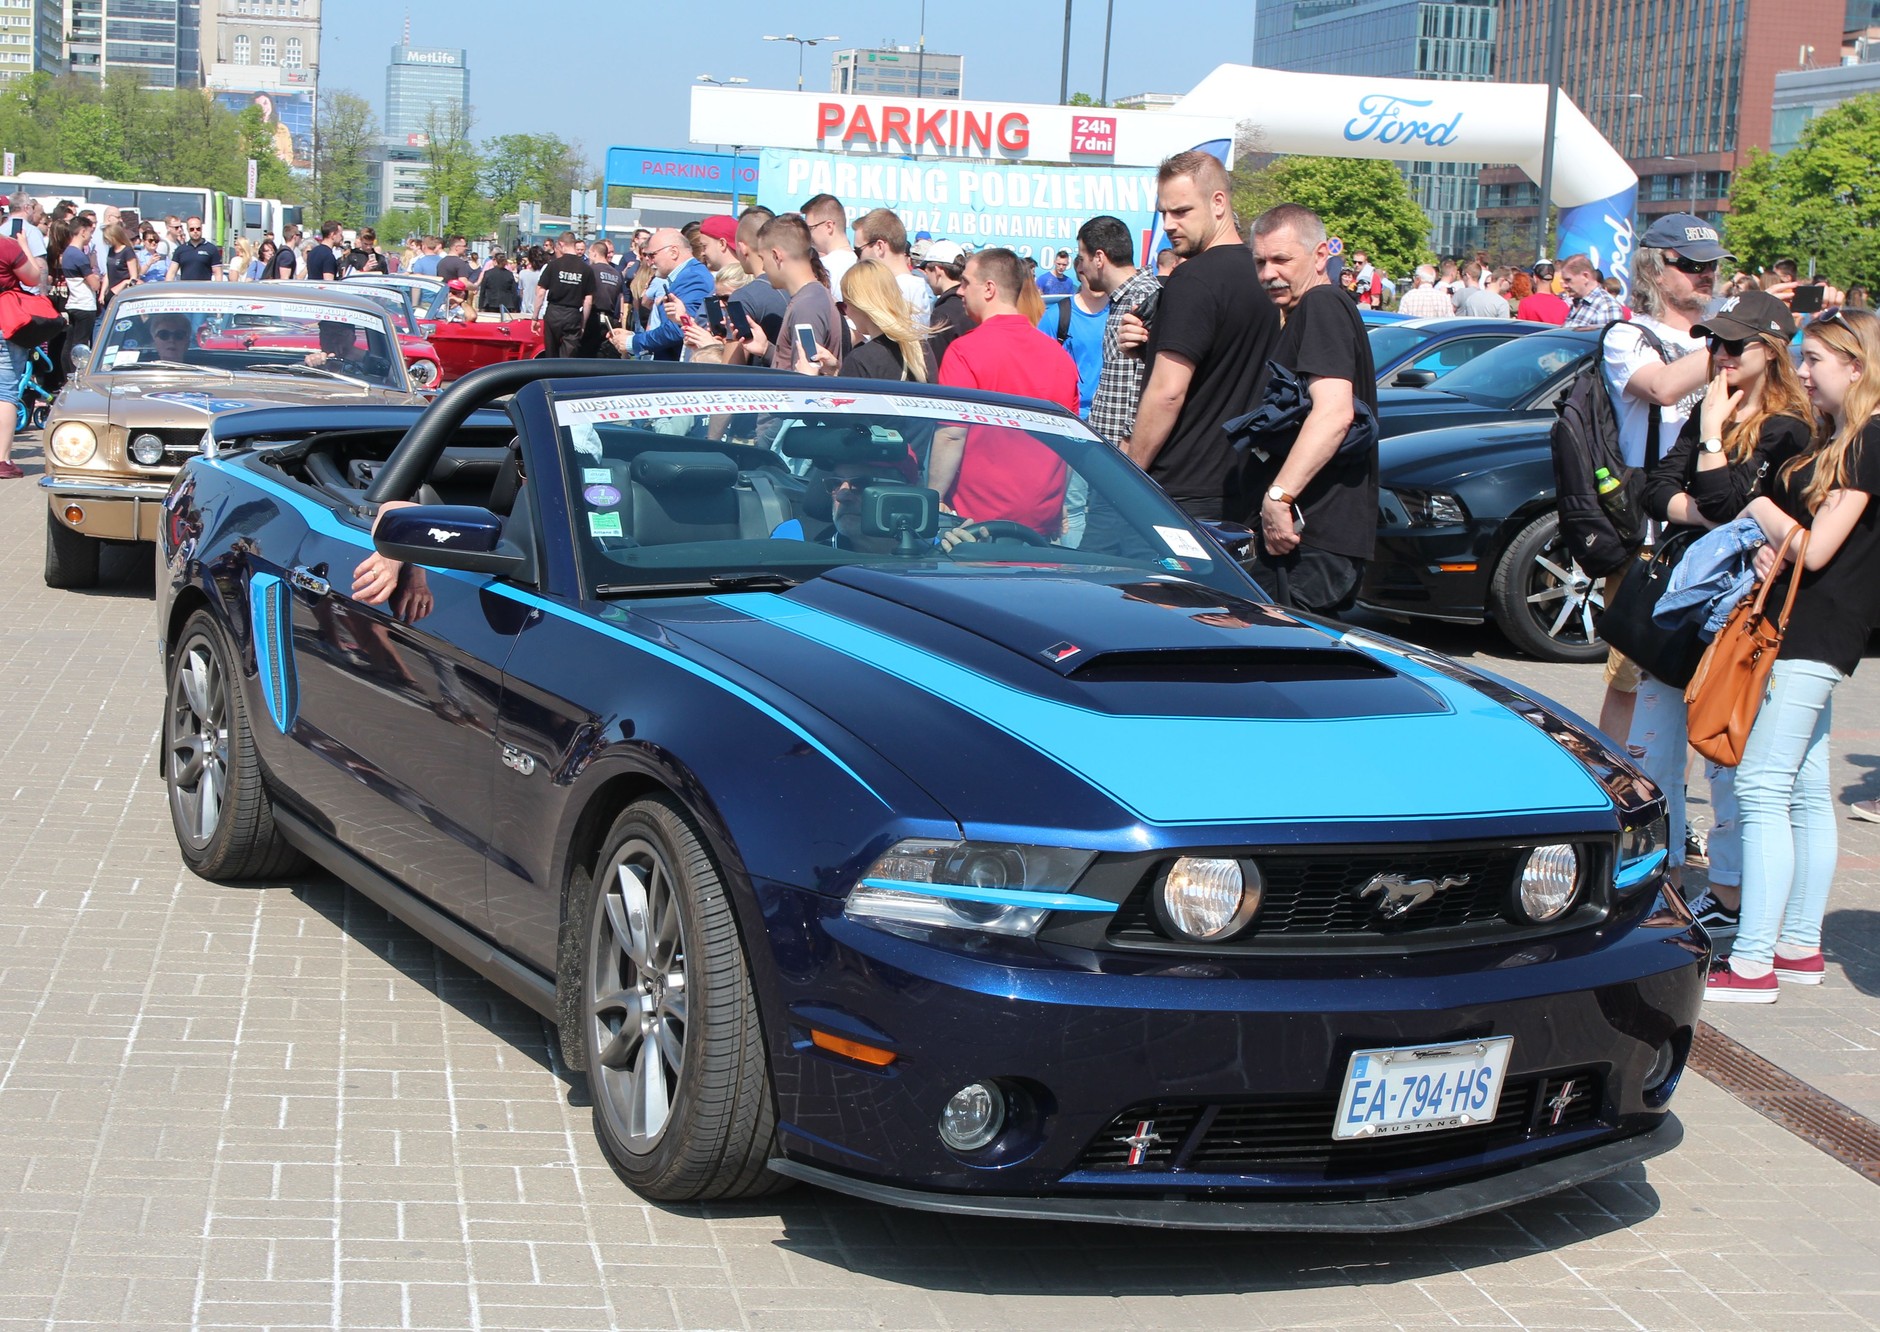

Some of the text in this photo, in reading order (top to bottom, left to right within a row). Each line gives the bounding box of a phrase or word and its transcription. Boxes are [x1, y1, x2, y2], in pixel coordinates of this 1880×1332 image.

[407, 51, 455, 64] MetLife
[817, 102, 1030, 151] PARKING
[1077, 118, 1111, 135] 24h
[1343, 94, 1463, 147] Ford
[1074, 136, 1113, 152] 7dni
[641, 160, 721, 180] PARKING
[787, 157, 1158, 213] PARKING PODZIEMNY
[947, 210, 1096, 240] ABONAMENT
[284, 304, 324, 314] MUSTANG
[567, 395, 651, 414] MUSTANG
[654, 393, 699, 407] CLUB
[727, 391, 795, 404] FRANCE
[893, 397, 969, 413] MUSTANG
[599, 404, 781, 421] 10 TH ANNIVERSARY
[959, 413, 1021, 428] 2018
[1355, 1069, 1363, 1078] F
[1346, 1066, 1492, 1124] EA-794-HS
[1377, 1119, 1458, 1133] MUSTANG
